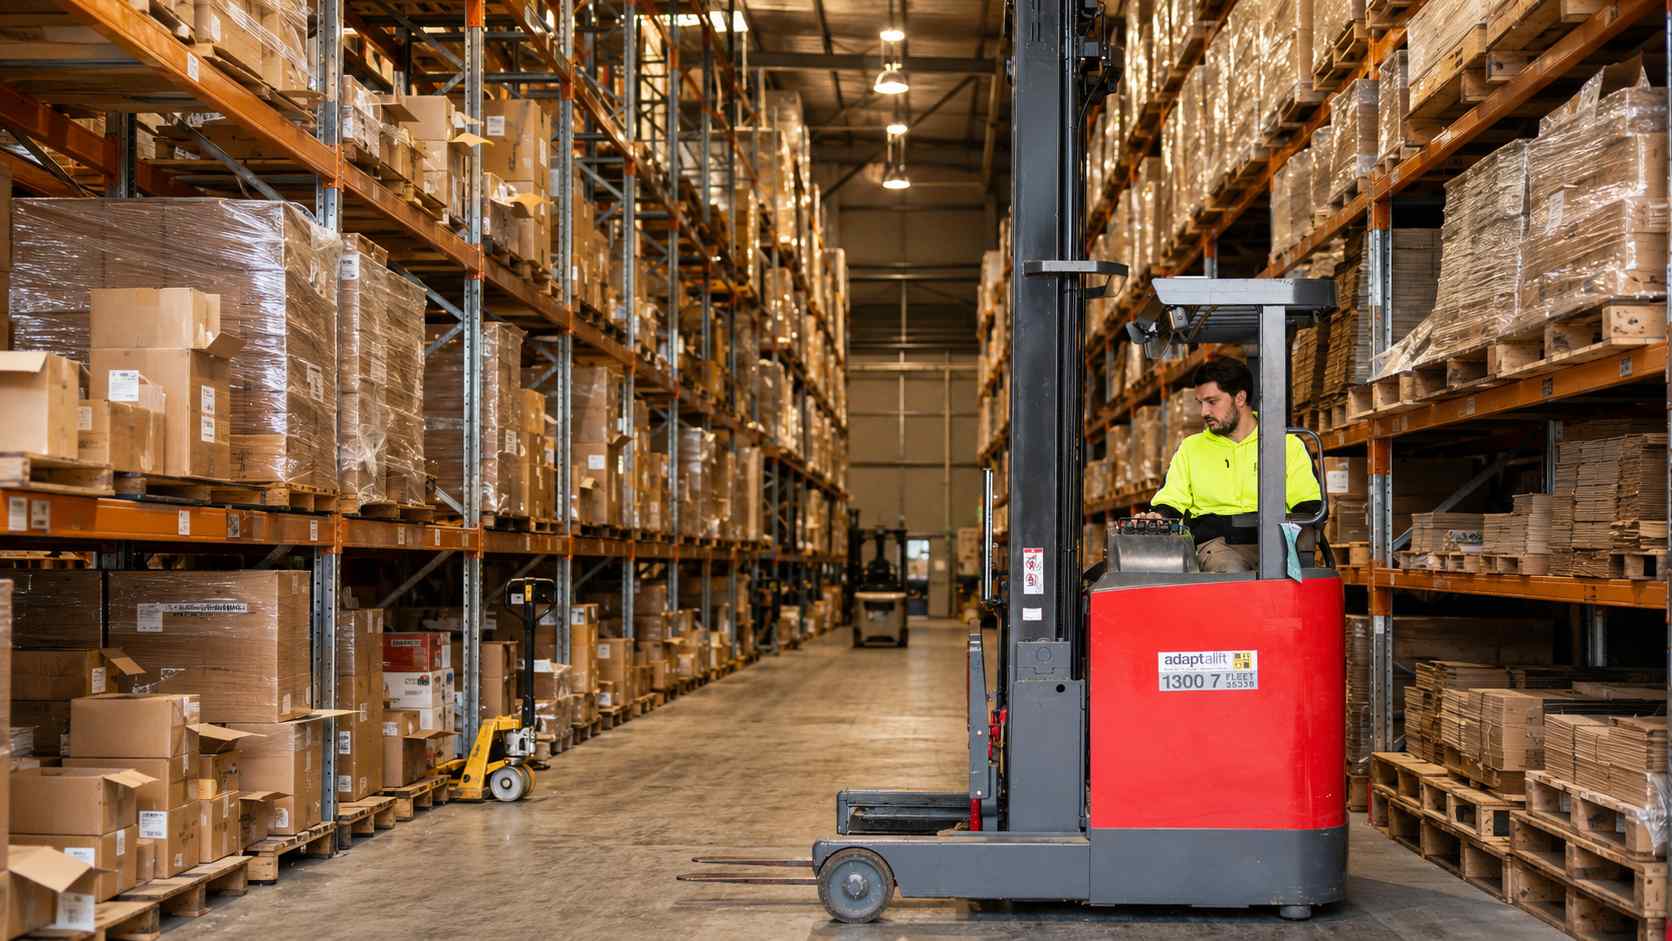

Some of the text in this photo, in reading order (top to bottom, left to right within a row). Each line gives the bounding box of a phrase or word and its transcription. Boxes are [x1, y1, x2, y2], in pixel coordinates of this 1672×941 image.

[1165, 653, 1227, 667] adaptalift
[1162, 674, 1221, 689] 1300 7
[1226, 672, 1254, 681] FLEET
